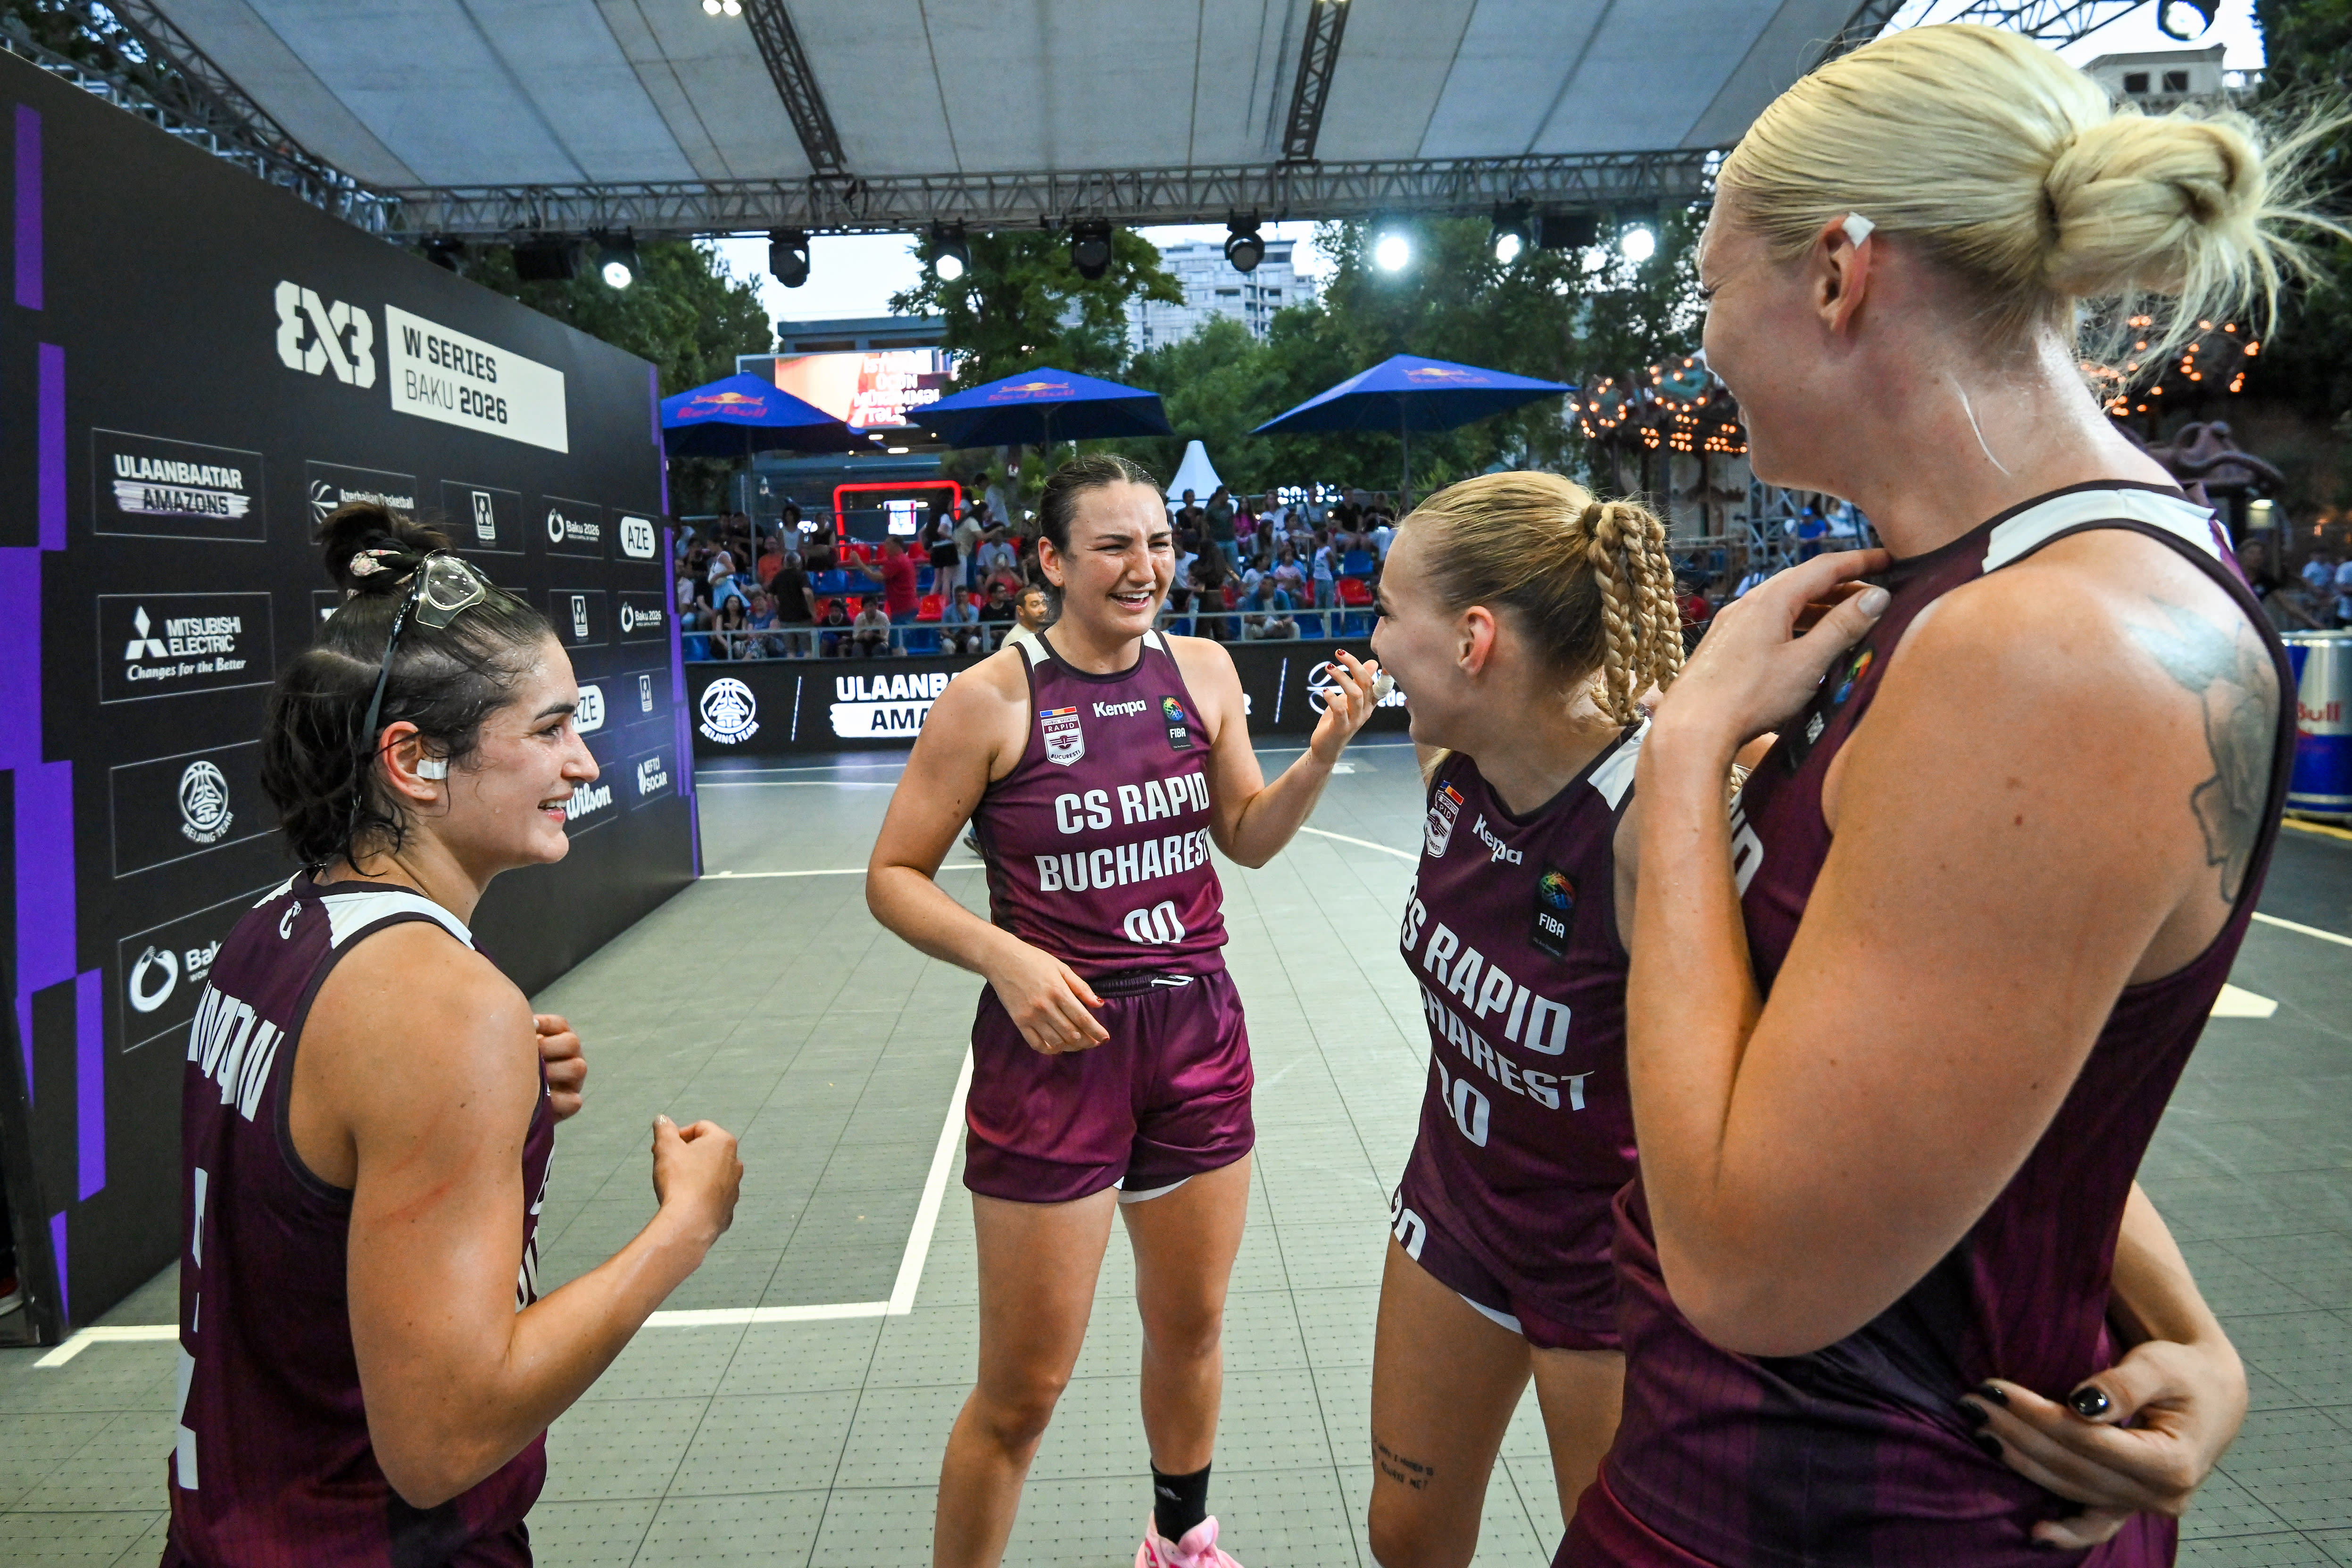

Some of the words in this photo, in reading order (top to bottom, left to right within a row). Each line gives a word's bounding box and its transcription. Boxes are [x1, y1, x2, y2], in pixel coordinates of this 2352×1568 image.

[403, 325, 421, 358] W
[428, 335, 497, 383] SERIES
[406, 369, 453, 410] BAKU
[460, 386, 507, 424] 2026
[114, 454, 243, 489] ULAANBAATAR
[143, 489, 229, 515] AMAZONS
[566, 520, 583, 534] Baku
[584, 523, 600, 536] 2026
[628, 525, 649, 550] AZE
[166, 616, 241, 637] MITSUBISHI
[635, 611, 648, 621] Baku
[648, 610, 662, 621] 2026
[169, 636, 235, 657] ELECTRIC
[126, 664, 176, 682] Changes
[179, 662, 195, 677] for
[198, 660, 214, 673] the
[215, 657, 246, 672] Better
[836, 672, 961, 702] ULAANB
[1093, 699, 1147, 718] Kempa
[699, 723, 735, 745] BEIJING
[735, 721, 760, 742] TEAM
[1048, 722, 1074, 732] RAPID
[1170, 727, 1186, 739] FIBA
[1051, 749, 1080, 759] BUCURESTI
[646, 771, 667, 793] SOCAR
[566, 782, 613, 821] Wilson
[1055, 789, 1112, 834] CS
[1117, 772, 1210, 825] RAPID
[181, 822, 216, 843] BEIJING
[216, 811, 234, 839] TEAM
[1123, 900, 1185, 945] 00
[1539, 913, 1565, 939] FIBA
[1423, 921, 1571, 1056] RAPID
